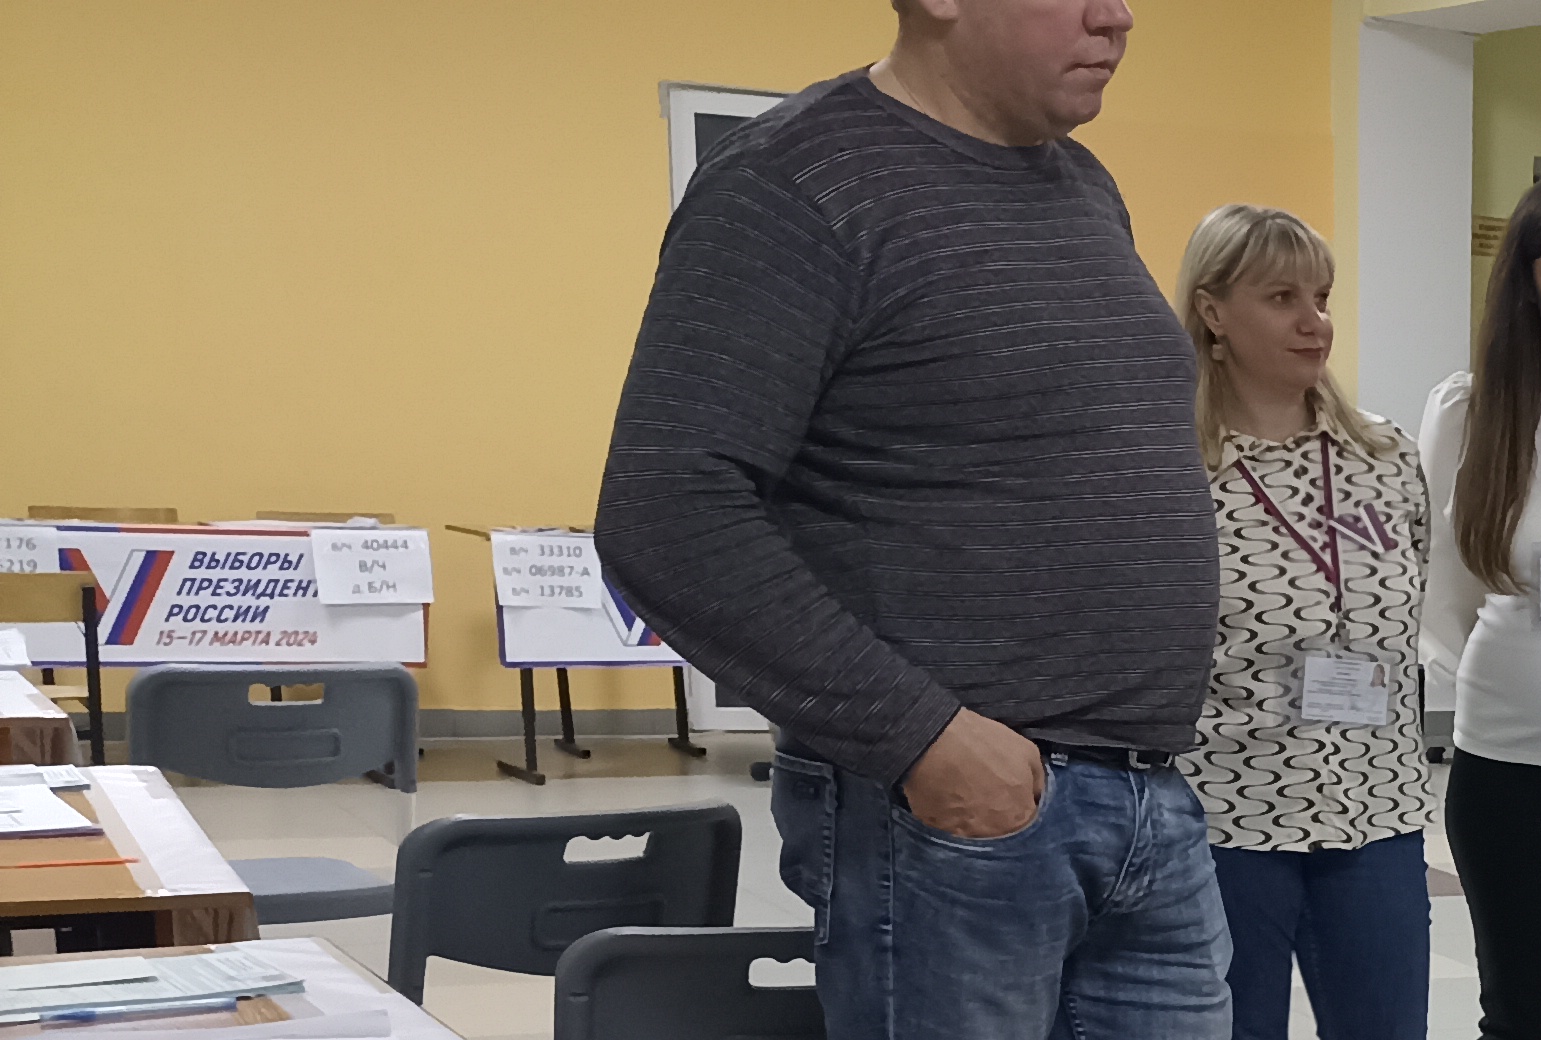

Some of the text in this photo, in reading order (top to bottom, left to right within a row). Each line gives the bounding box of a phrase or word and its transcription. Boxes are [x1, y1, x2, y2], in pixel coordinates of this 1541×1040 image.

[3, 536, 38, 551] 176
[0, 558, 38, 573] 219
[188, 550, 304, 571] ВЫБОРЫ
[164, 603, 271, 623] РОССИИ
[209, 629, 272, 647] МАРТА
[274, 629, 319, 647] 2024
